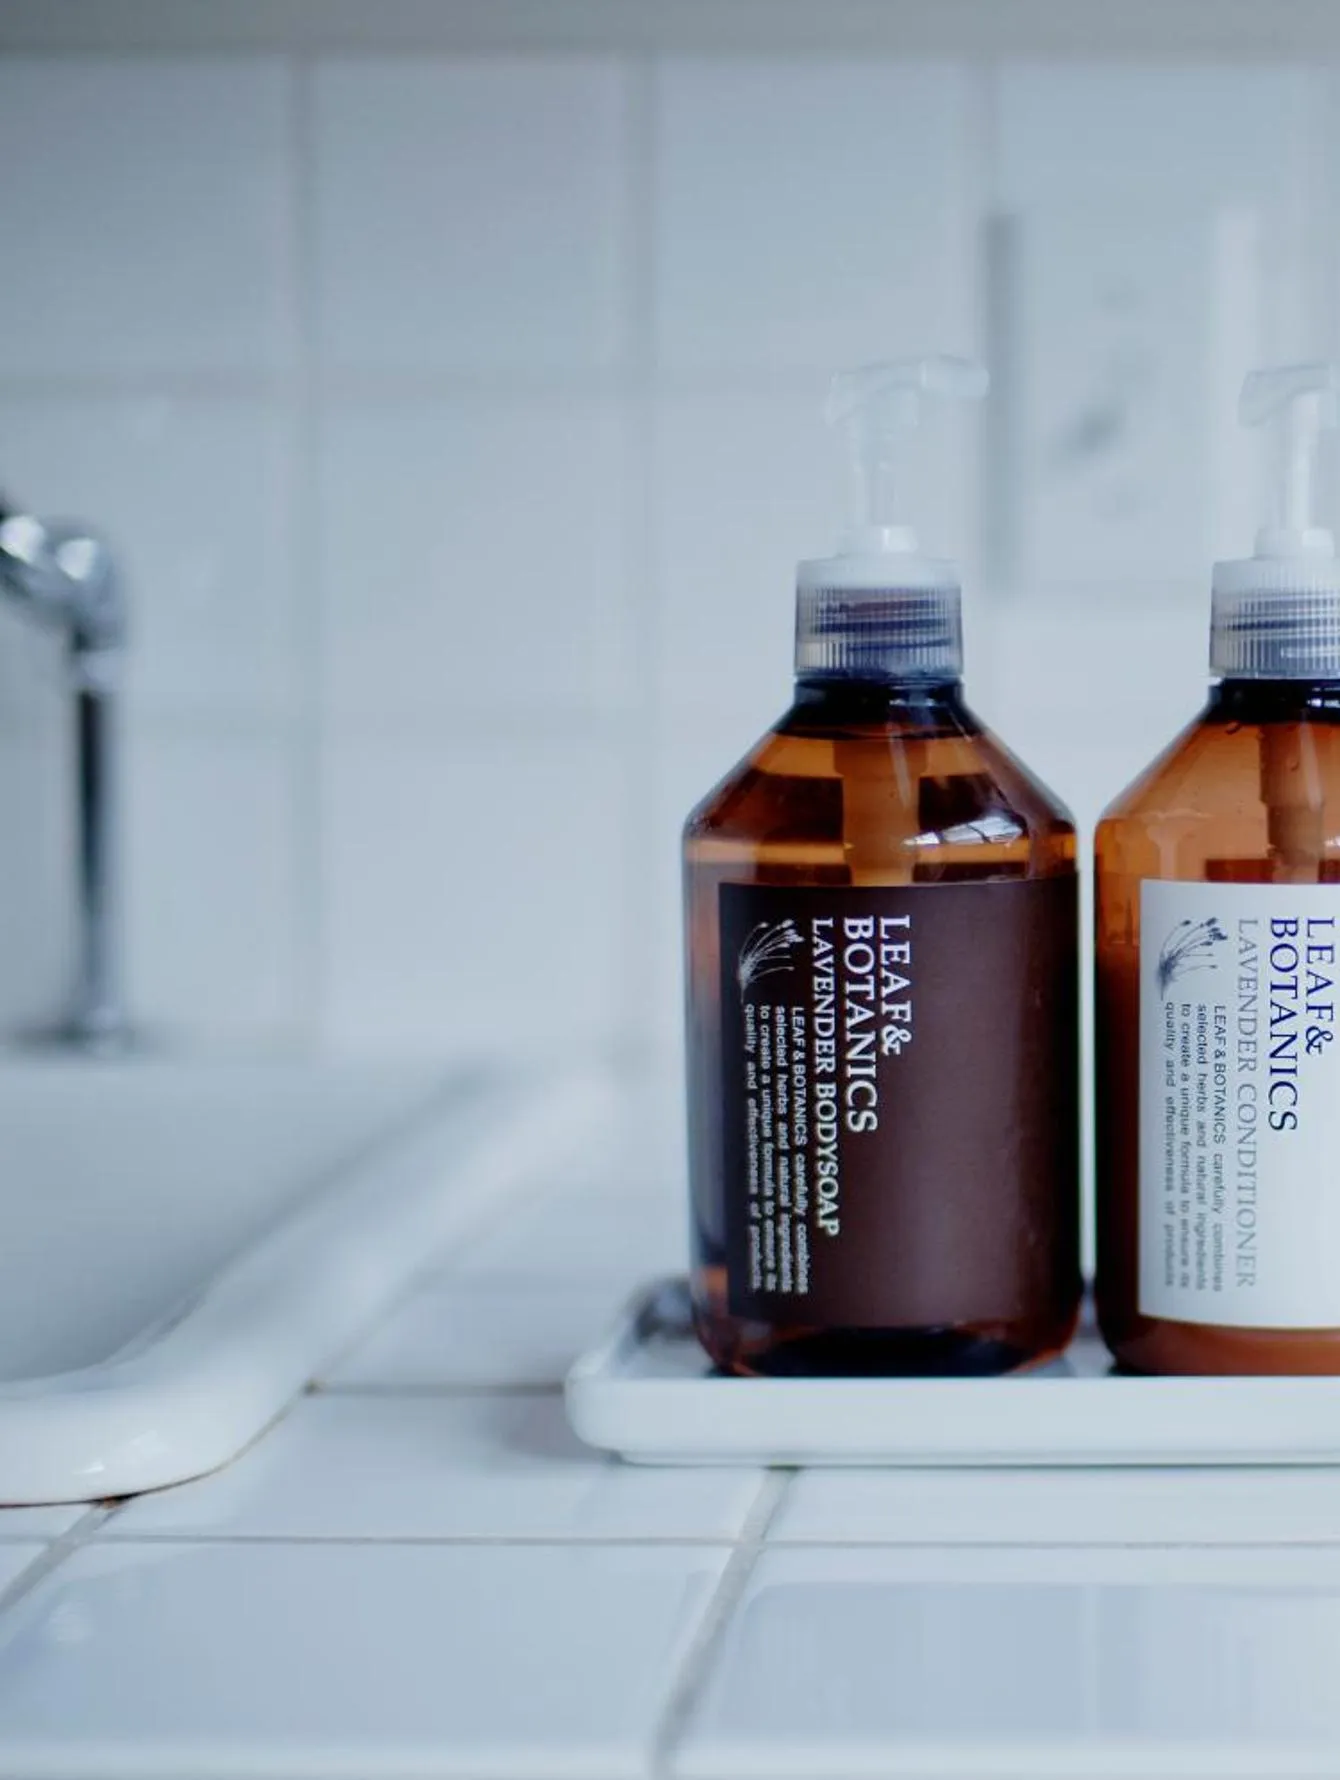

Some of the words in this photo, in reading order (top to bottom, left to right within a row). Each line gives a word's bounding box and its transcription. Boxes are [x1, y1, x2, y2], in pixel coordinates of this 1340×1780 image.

[812, 918, 837, 1073] LAVENDER
[879, 915, 912, 1055] LEAF&
[1237, 919, 1258, 1072] LAVENDER
[1305, 916, 1335, 1055] LEAF&
[743, 1005, 757, 1053] quality
[760, 1006, 771, 1019] to
[792, 1007, 805, 1047] LEAF
[843, 916, 878, 1133] BOTANICS
[1163, 1003, 1177, 1050] quality
[1181, 1004, 1192, 1017] to
[1214, 1006, 1227, 1047] LEAF
[1268, 917, 1299, 1131] BOTANICS
[761, 1025, 772, 1069] create
[776, 1006, 789, 1066] selected
[793, 1051, 805, 1060] &
[1181, 1023, 1192, 1067] create
[1196, 1005, 1209, 1065] selected
[1214, 1050, 1226, 1059] &
[746, 1062, 758, 1089] and
[762, 1075, 770, 1084] a
[777, 1074, 789, 1114] herbs
[1165, 1060, 1177, 1087] and
[1181, 1073, 1190, 1082] a
[1196, 1073, 1208, 1113] herbs
[760, 1090, 773, 1137] unique
[793, 1064, 807, 1145] BOTANICS
[1178, 1088, 1191, 1135] unique
[1213, 1063, 1226, 1144] BOTANICS
[778, 1122, 790, 1149] and
[1196, 1121, 1208, 1147] and
[763, 1143, 775, 1195] formula
[779, 1157, 792, 1206] natural
[816, 1082, 839, 1236] BODYSOAP
[1180, 1141, 1192, 1194] formula
[1196, 1156, 1208, 1205] natural
[793, 1154, 808, 1216] carefully
[1212, 1153, 1226, 1214] carefully
[1236, 1084, 1258, 1287] CONDITIONER
[749, 1202, 761, 1217] of
